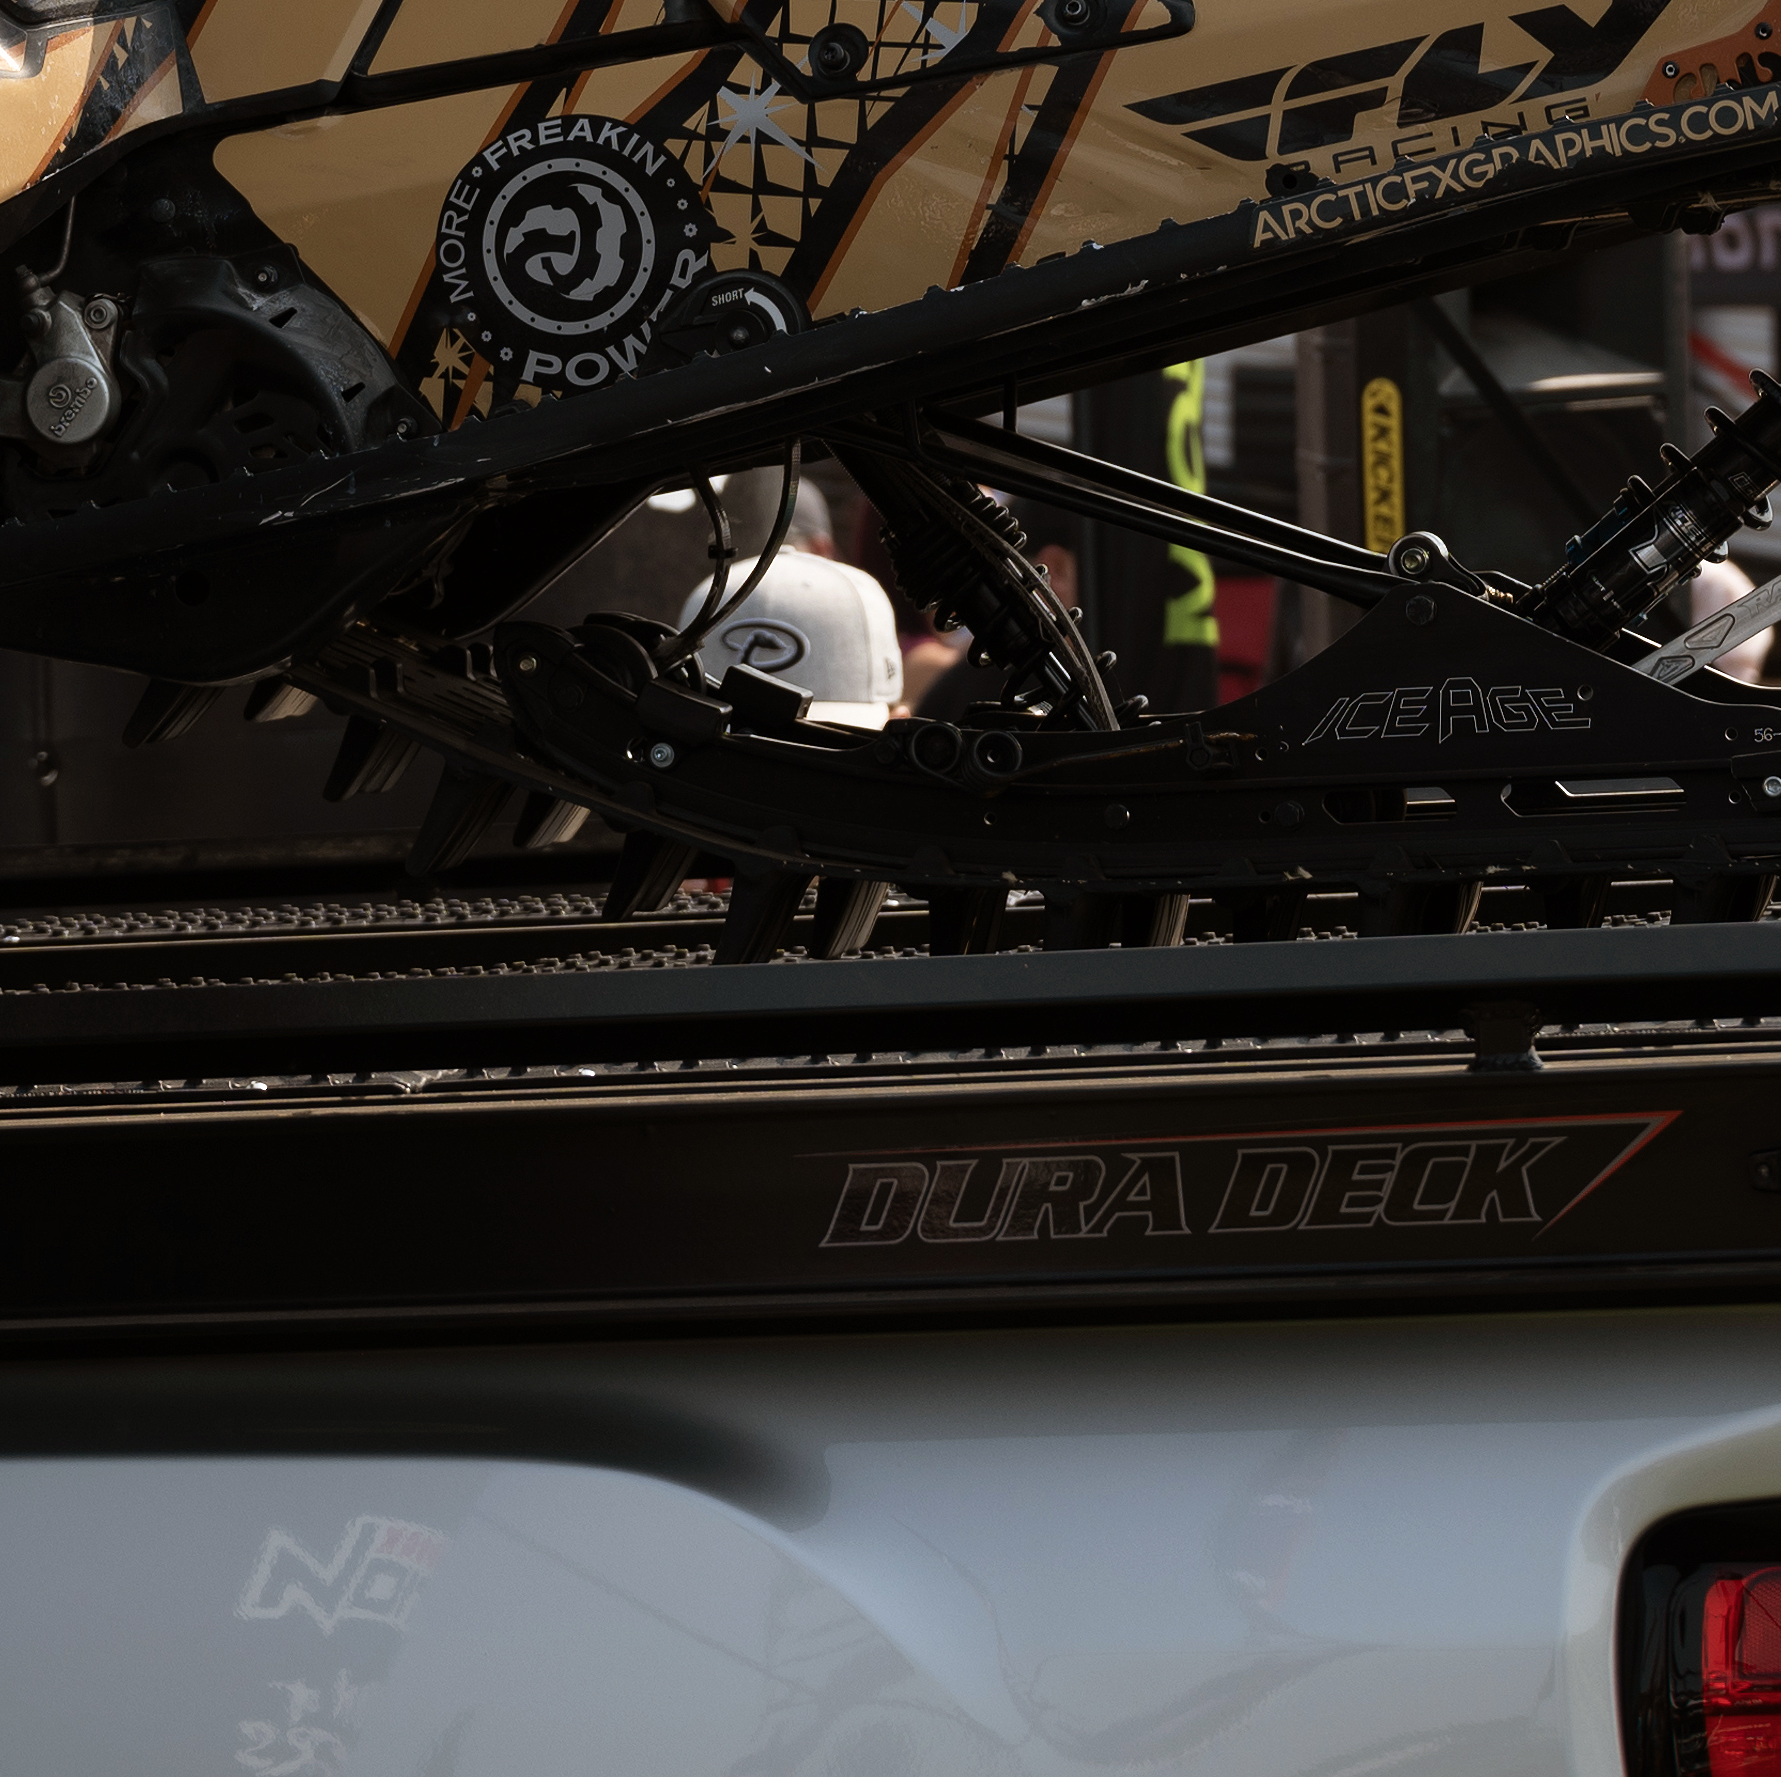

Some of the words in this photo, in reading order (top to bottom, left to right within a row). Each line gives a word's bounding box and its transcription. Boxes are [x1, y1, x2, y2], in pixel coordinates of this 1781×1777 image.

[439, 178, 481, 304] MORE
[482, 117, 667, 177] FREAKIN
[711, 288, 745, 307] SHORT
[50, 377, 98, 438] brembo
[819, 1151, 1191, 1247] DURA
[1208, 1137, 1569, 1234] DECK
